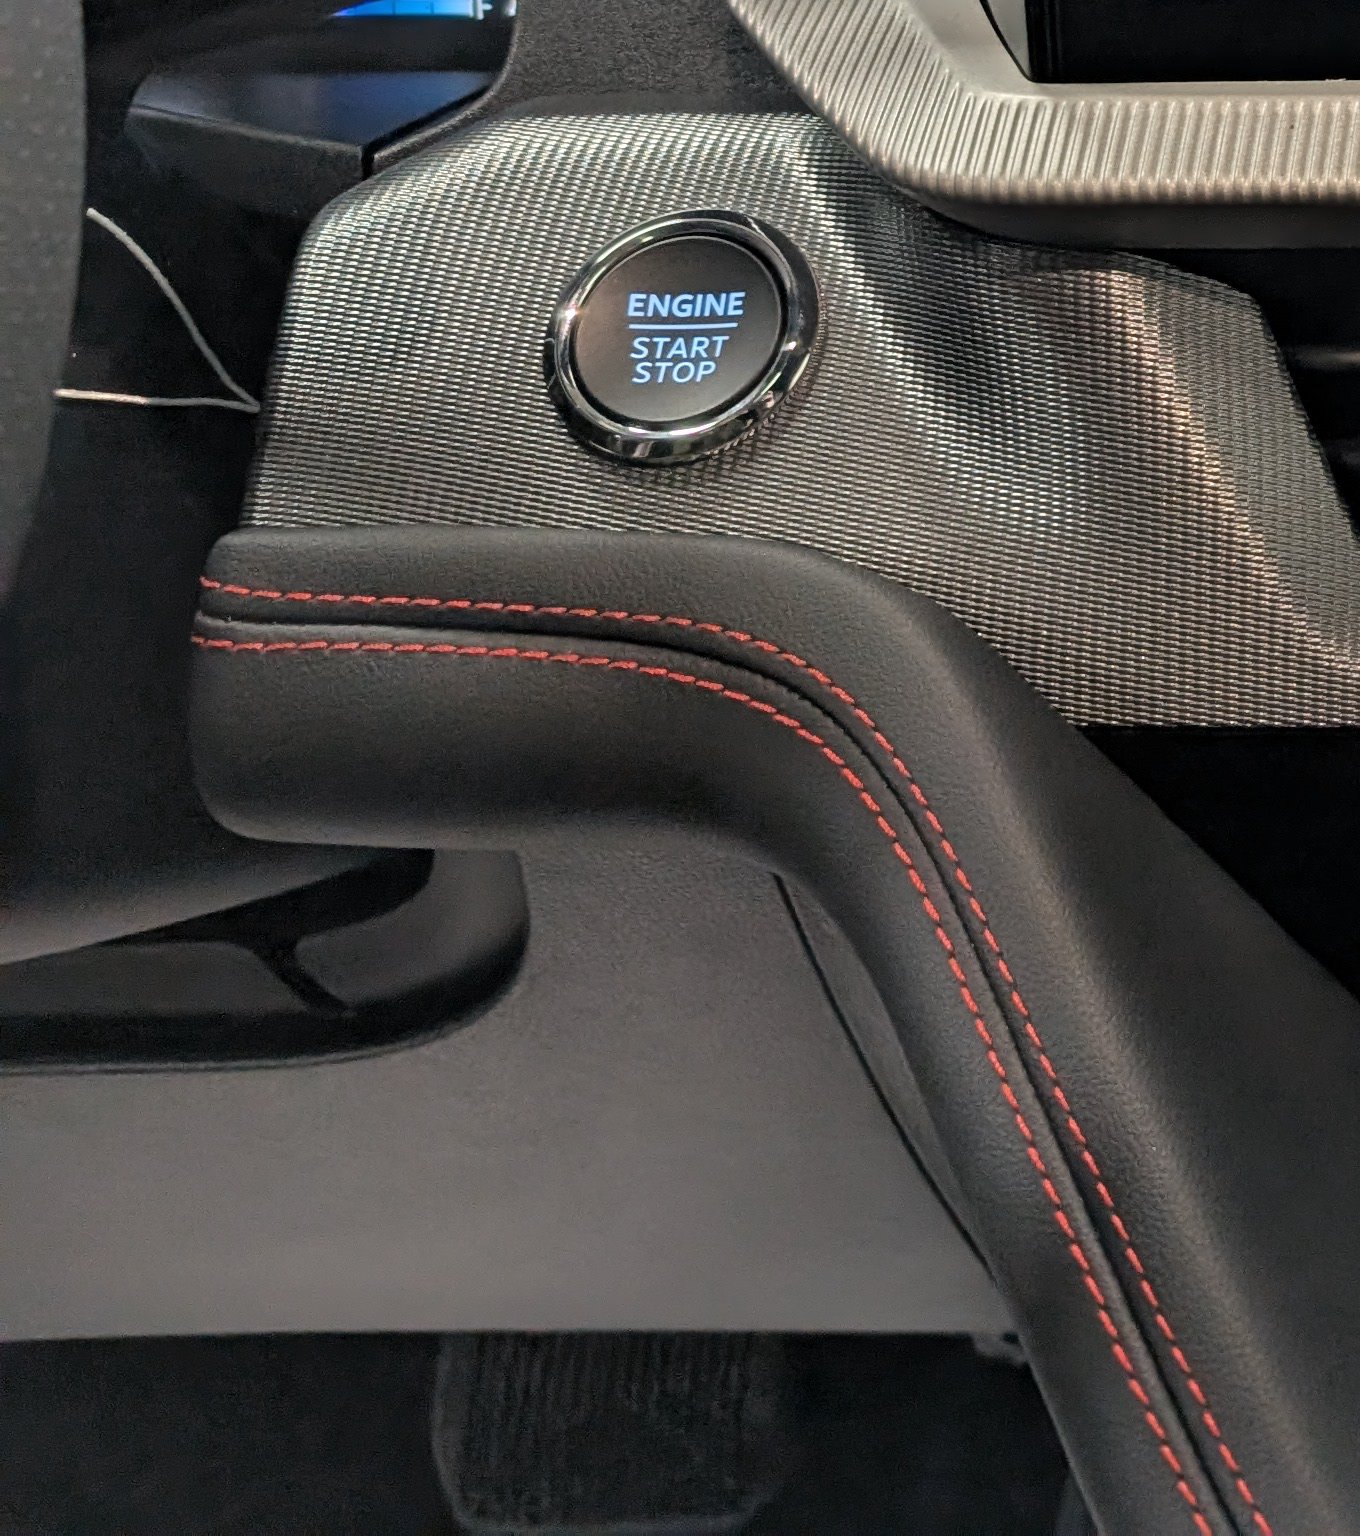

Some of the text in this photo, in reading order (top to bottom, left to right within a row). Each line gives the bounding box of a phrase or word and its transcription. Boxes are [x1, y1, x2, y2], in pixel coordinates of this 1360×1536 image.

[626, 291, 746, 318] ENGINE
[629, 335, 730, 360] START
[631, 360, 717, 384] STOP
